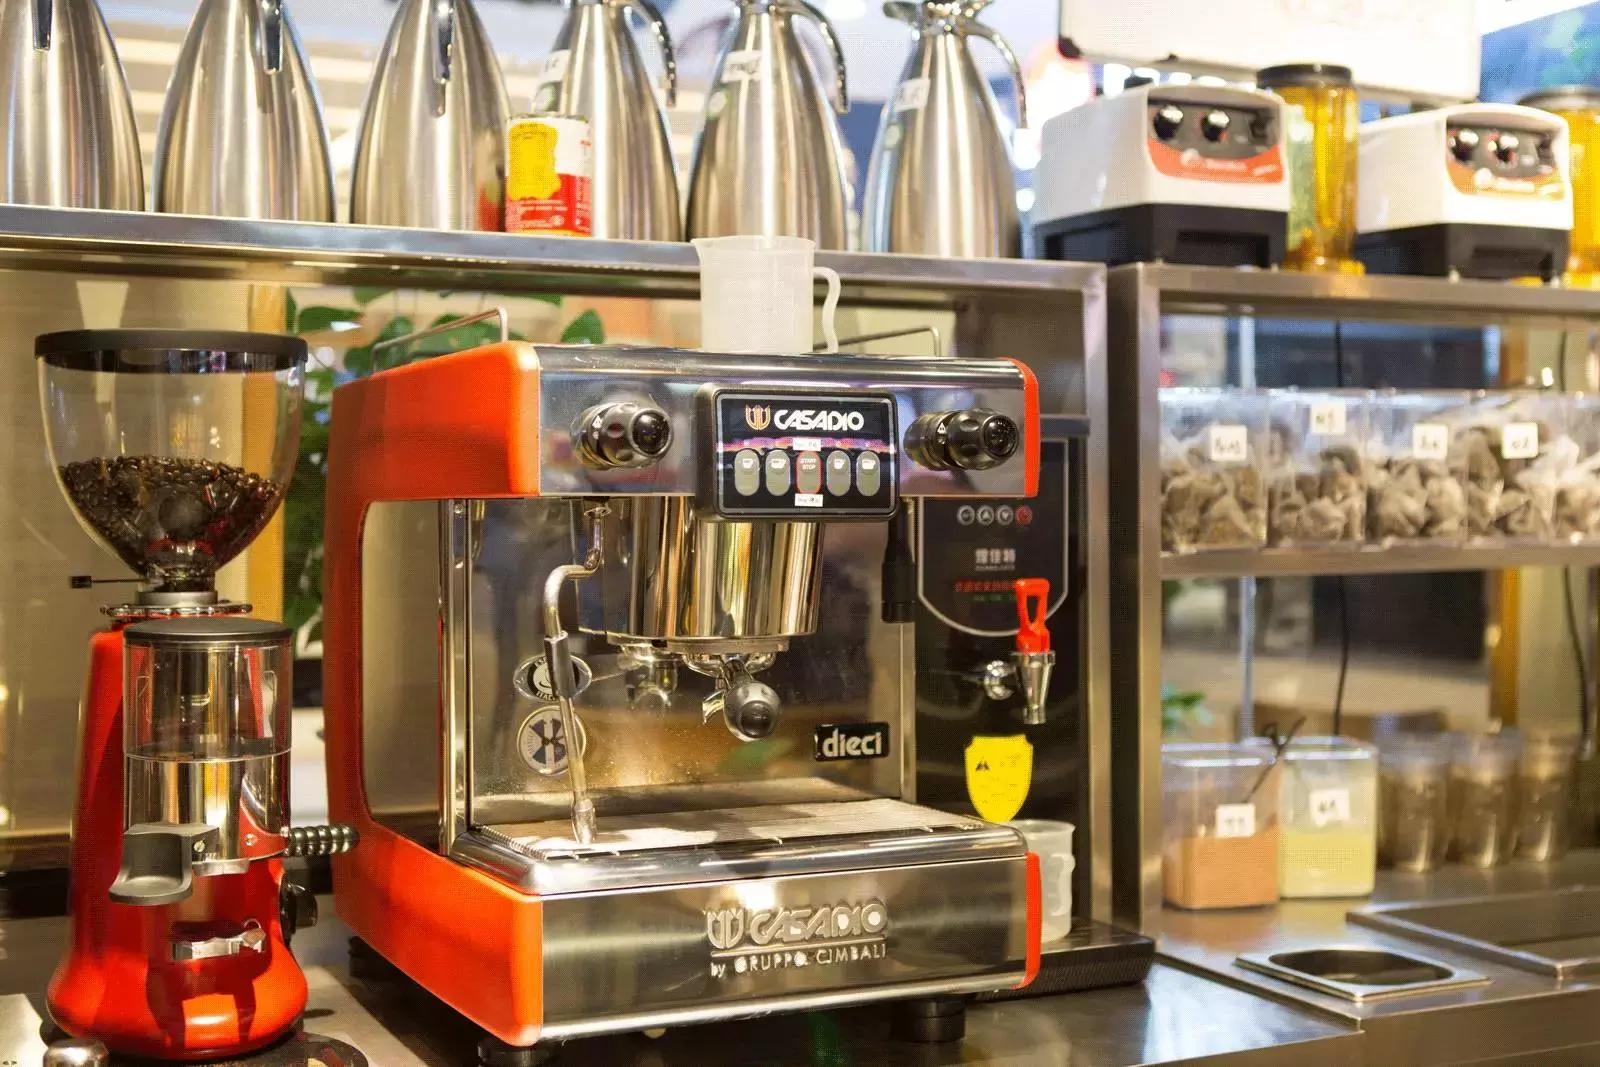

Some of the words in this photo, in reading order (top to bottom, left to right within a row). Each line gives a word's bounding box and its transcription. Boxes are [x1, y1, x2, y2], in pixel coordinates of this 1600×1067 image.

[773, 409, 865, 431] CASADIO
[823, 728, 882, 757] dieci
[750, 903, 888, 945] CASADIO
[710, 961, 726, 978] by
[734, 951, 807, 974] GRUPPO
[816, 943, 887, 965] CIMBALI
